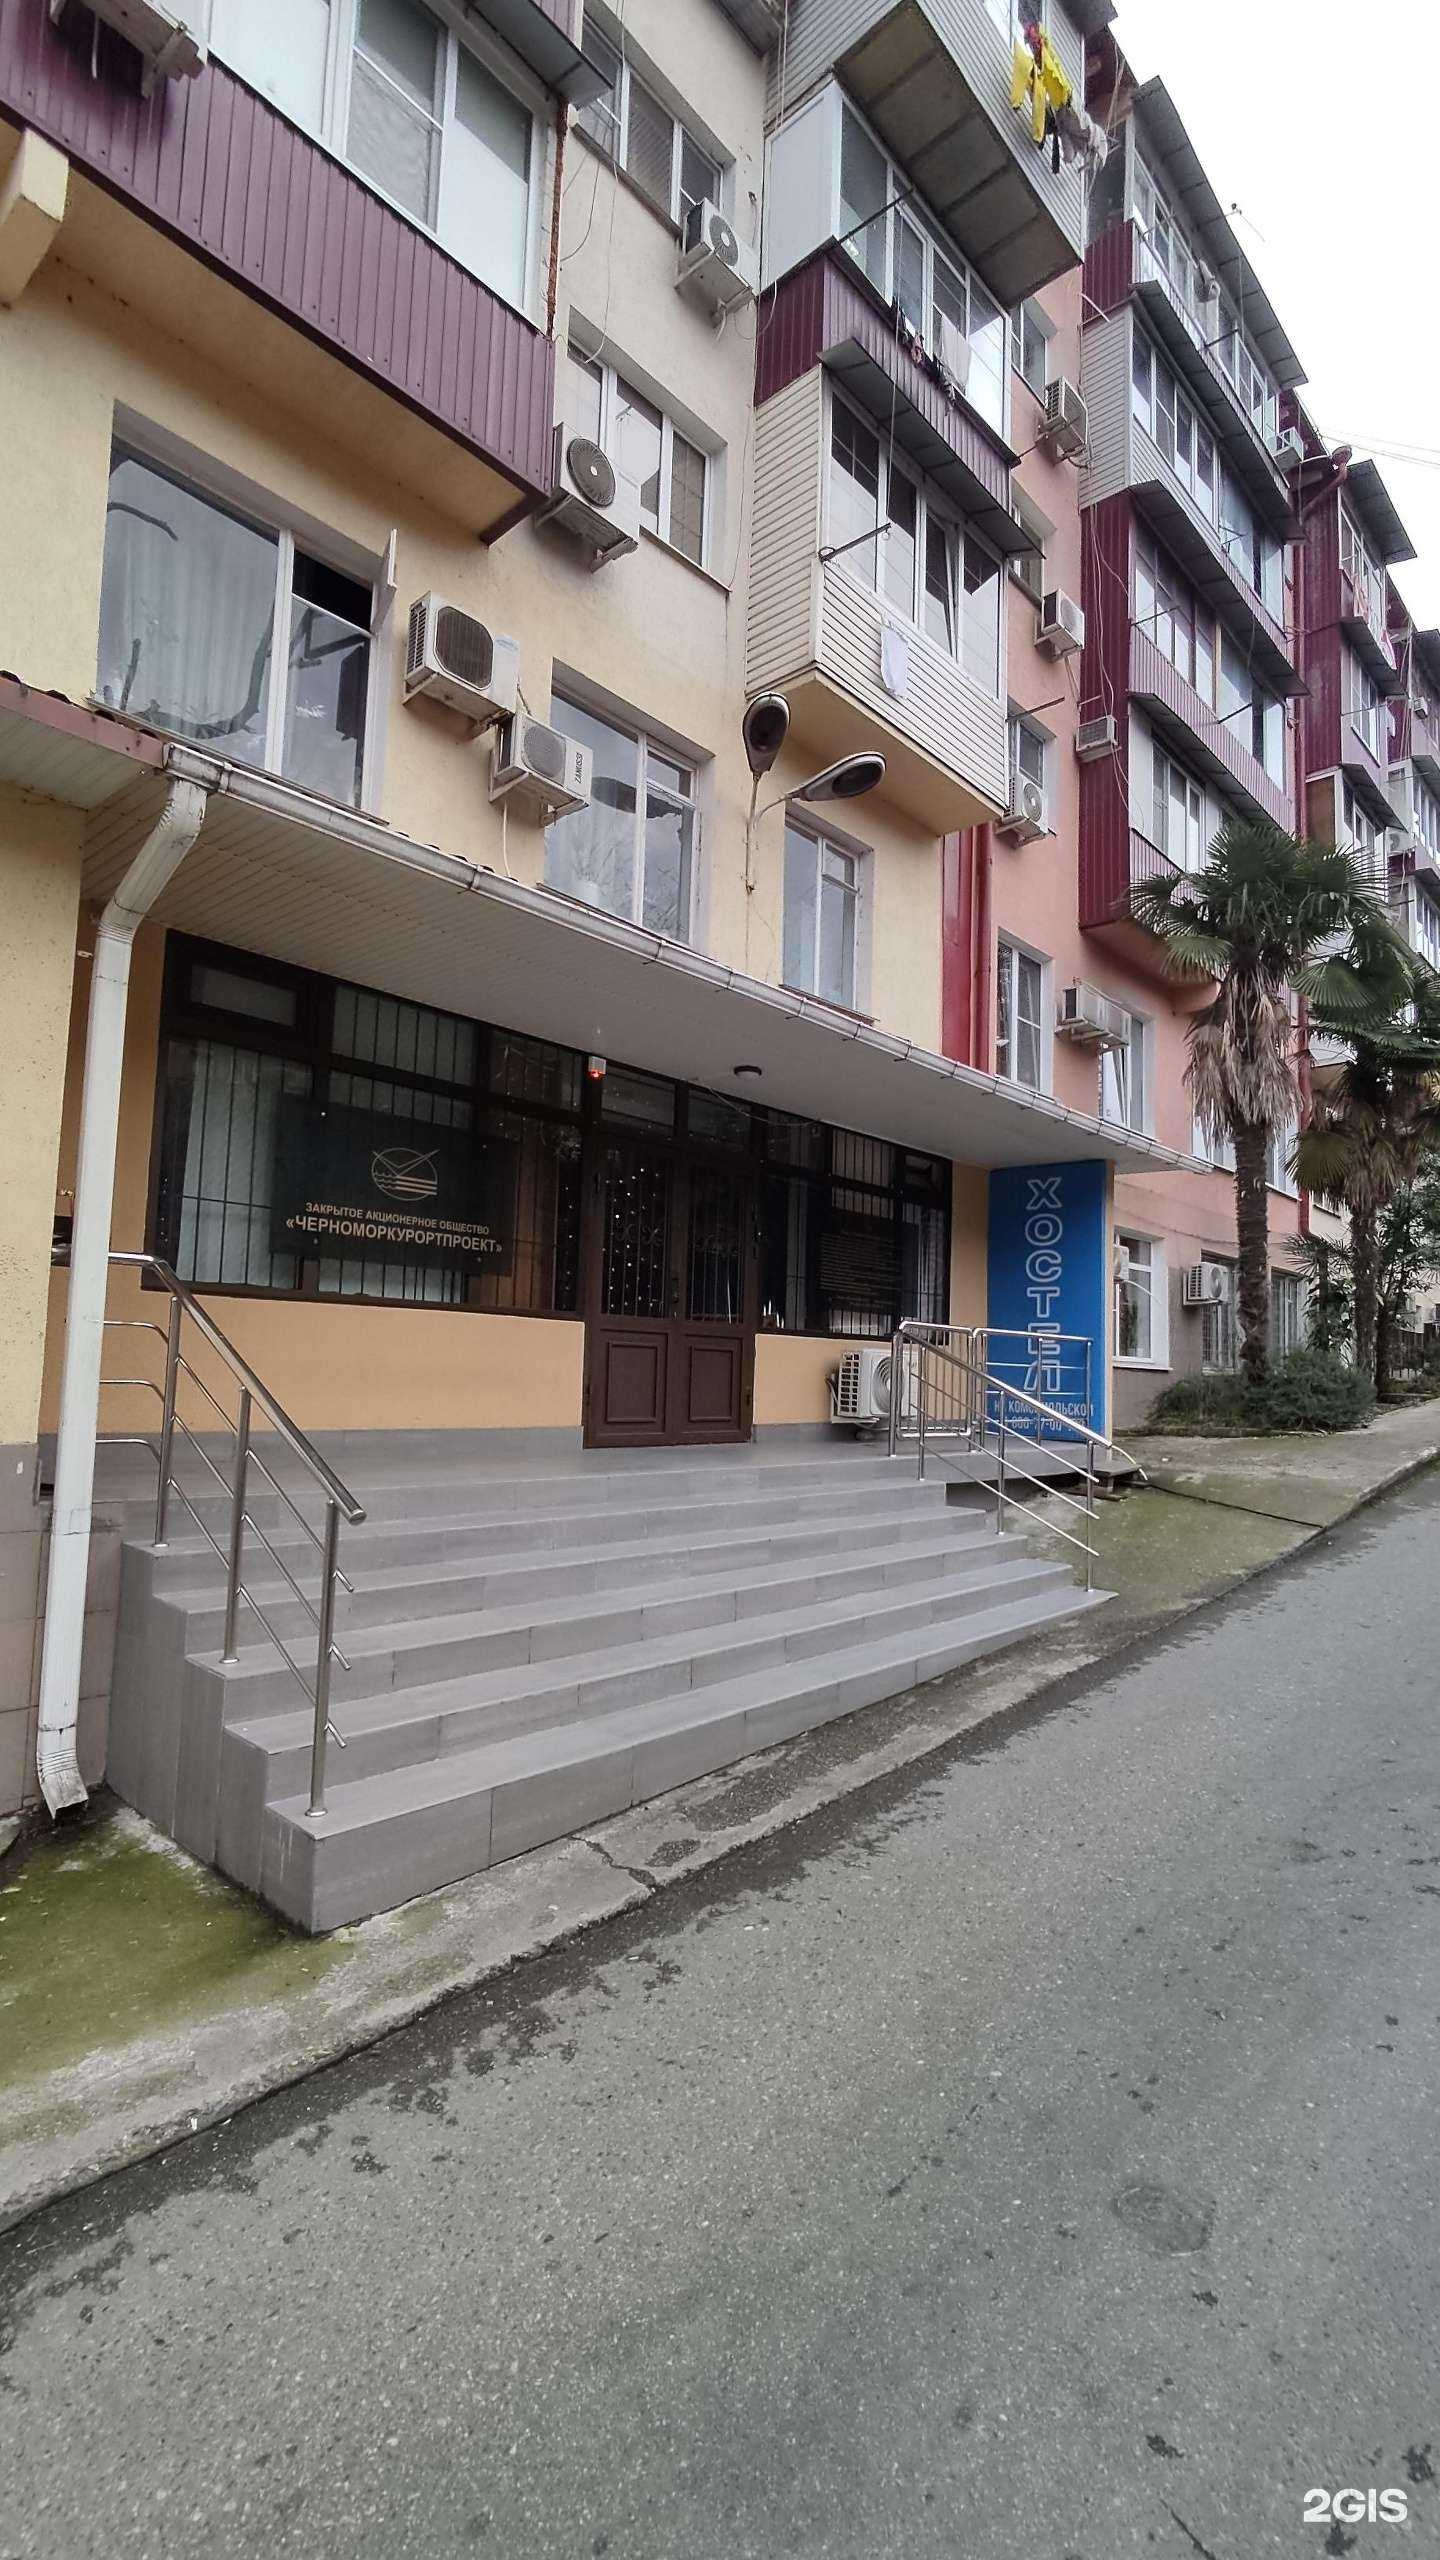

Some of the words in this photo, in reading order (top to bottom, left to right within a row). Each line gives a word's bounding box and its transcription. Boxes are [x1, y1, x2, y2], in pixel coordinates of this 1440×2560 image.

[285, 1214, 503, 1253] «ЧЕРНОМОРКУРОРТПРОЕКТ»
[305, 1201, 364, 1219] ЗАКРЫТОЕ
[365, 1209, 438, 1229] АКЦИОНЕРНОЕ
[439, 1219, 490, 1236] ОБЩЕСТВО
[1024, 1177, 1063, 1392] ХОСТЕЛ
